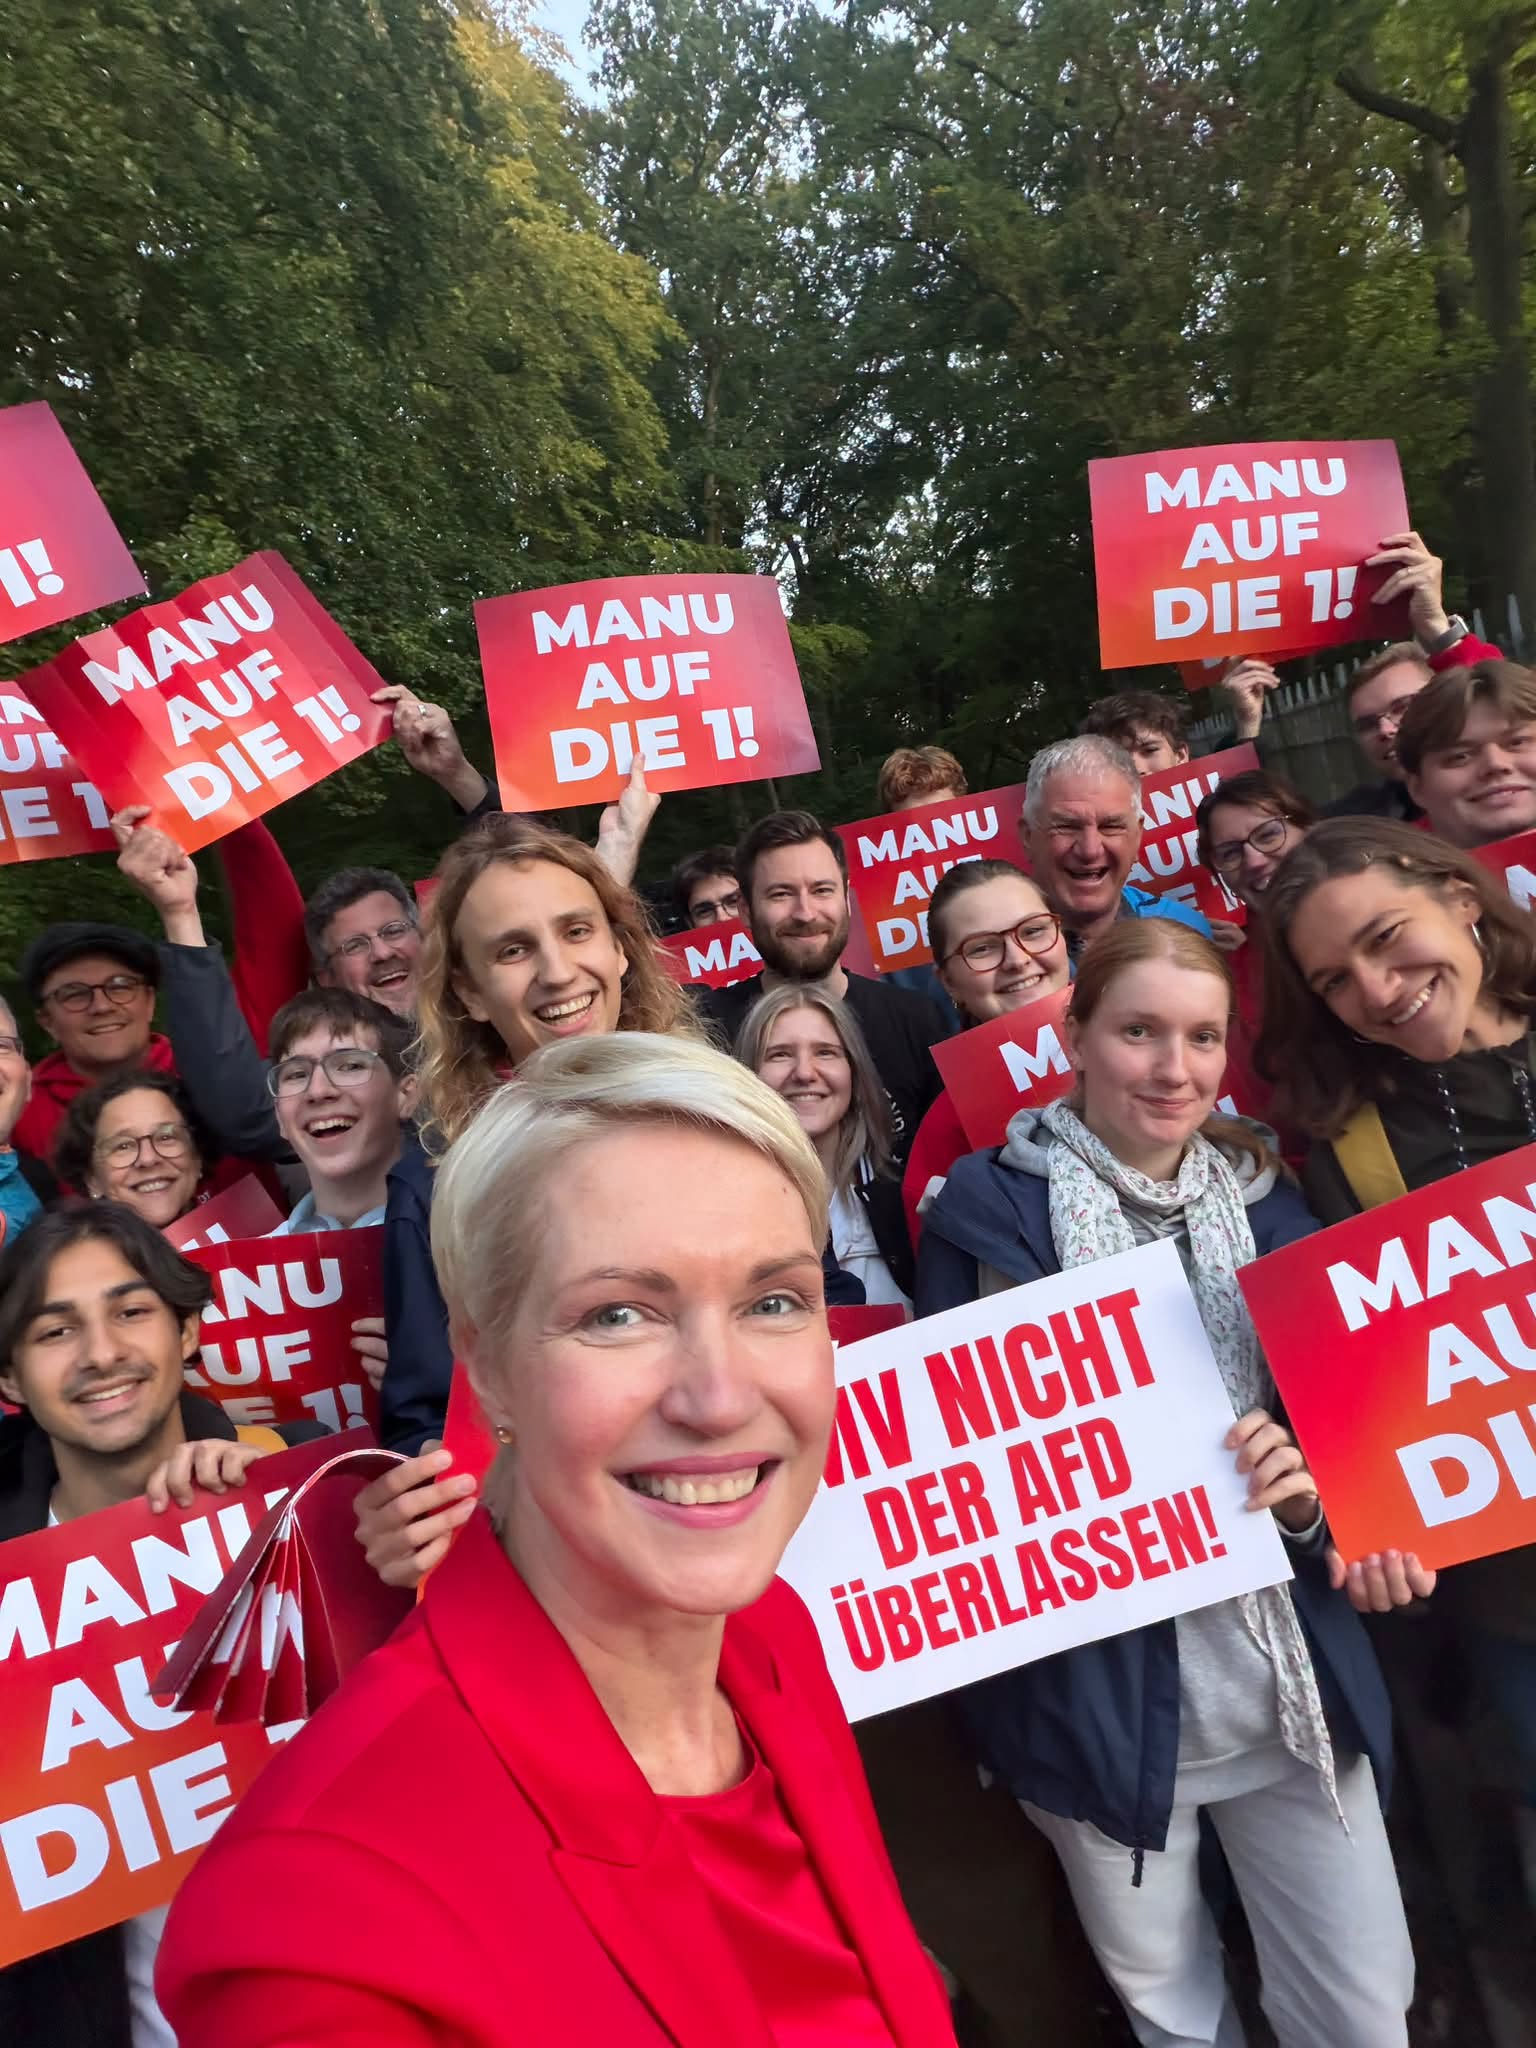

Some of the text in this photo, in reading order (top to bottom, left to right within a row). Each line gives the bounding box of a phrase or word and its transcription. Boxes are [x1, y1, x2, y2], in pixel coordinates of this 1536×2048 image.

[1145, 458, 1347, 513] MANU
[1181, 511, 1319, 569] AUF
[532, 593, 734, 654] MANU
[1153, 566, 1358, 640] DIE 1!
[82, 584, 274, 706] MANU
[576, 651, 710, 710] AUF
[165, 649, 282, 746] AUF
[0, 732, 70, 773] UF
[164, 685, 361, 821] DIE 1!
[550, 706, 760, 783] DIE 1!
[857, 806, 999, 868] MANU
[1141, 771, 1220, 831] NU
[893, 854, 983, 906] AU
[924, 1288, 1155, 1448] NICHT
[863, 1417, 1132, 1570] DER AFD
[1396, 1404, 1536, 1527] DI
[830, 1485, 1228, 1672] ÜBERLASSEN!
[0, 1742, 237, 1911] DIE
